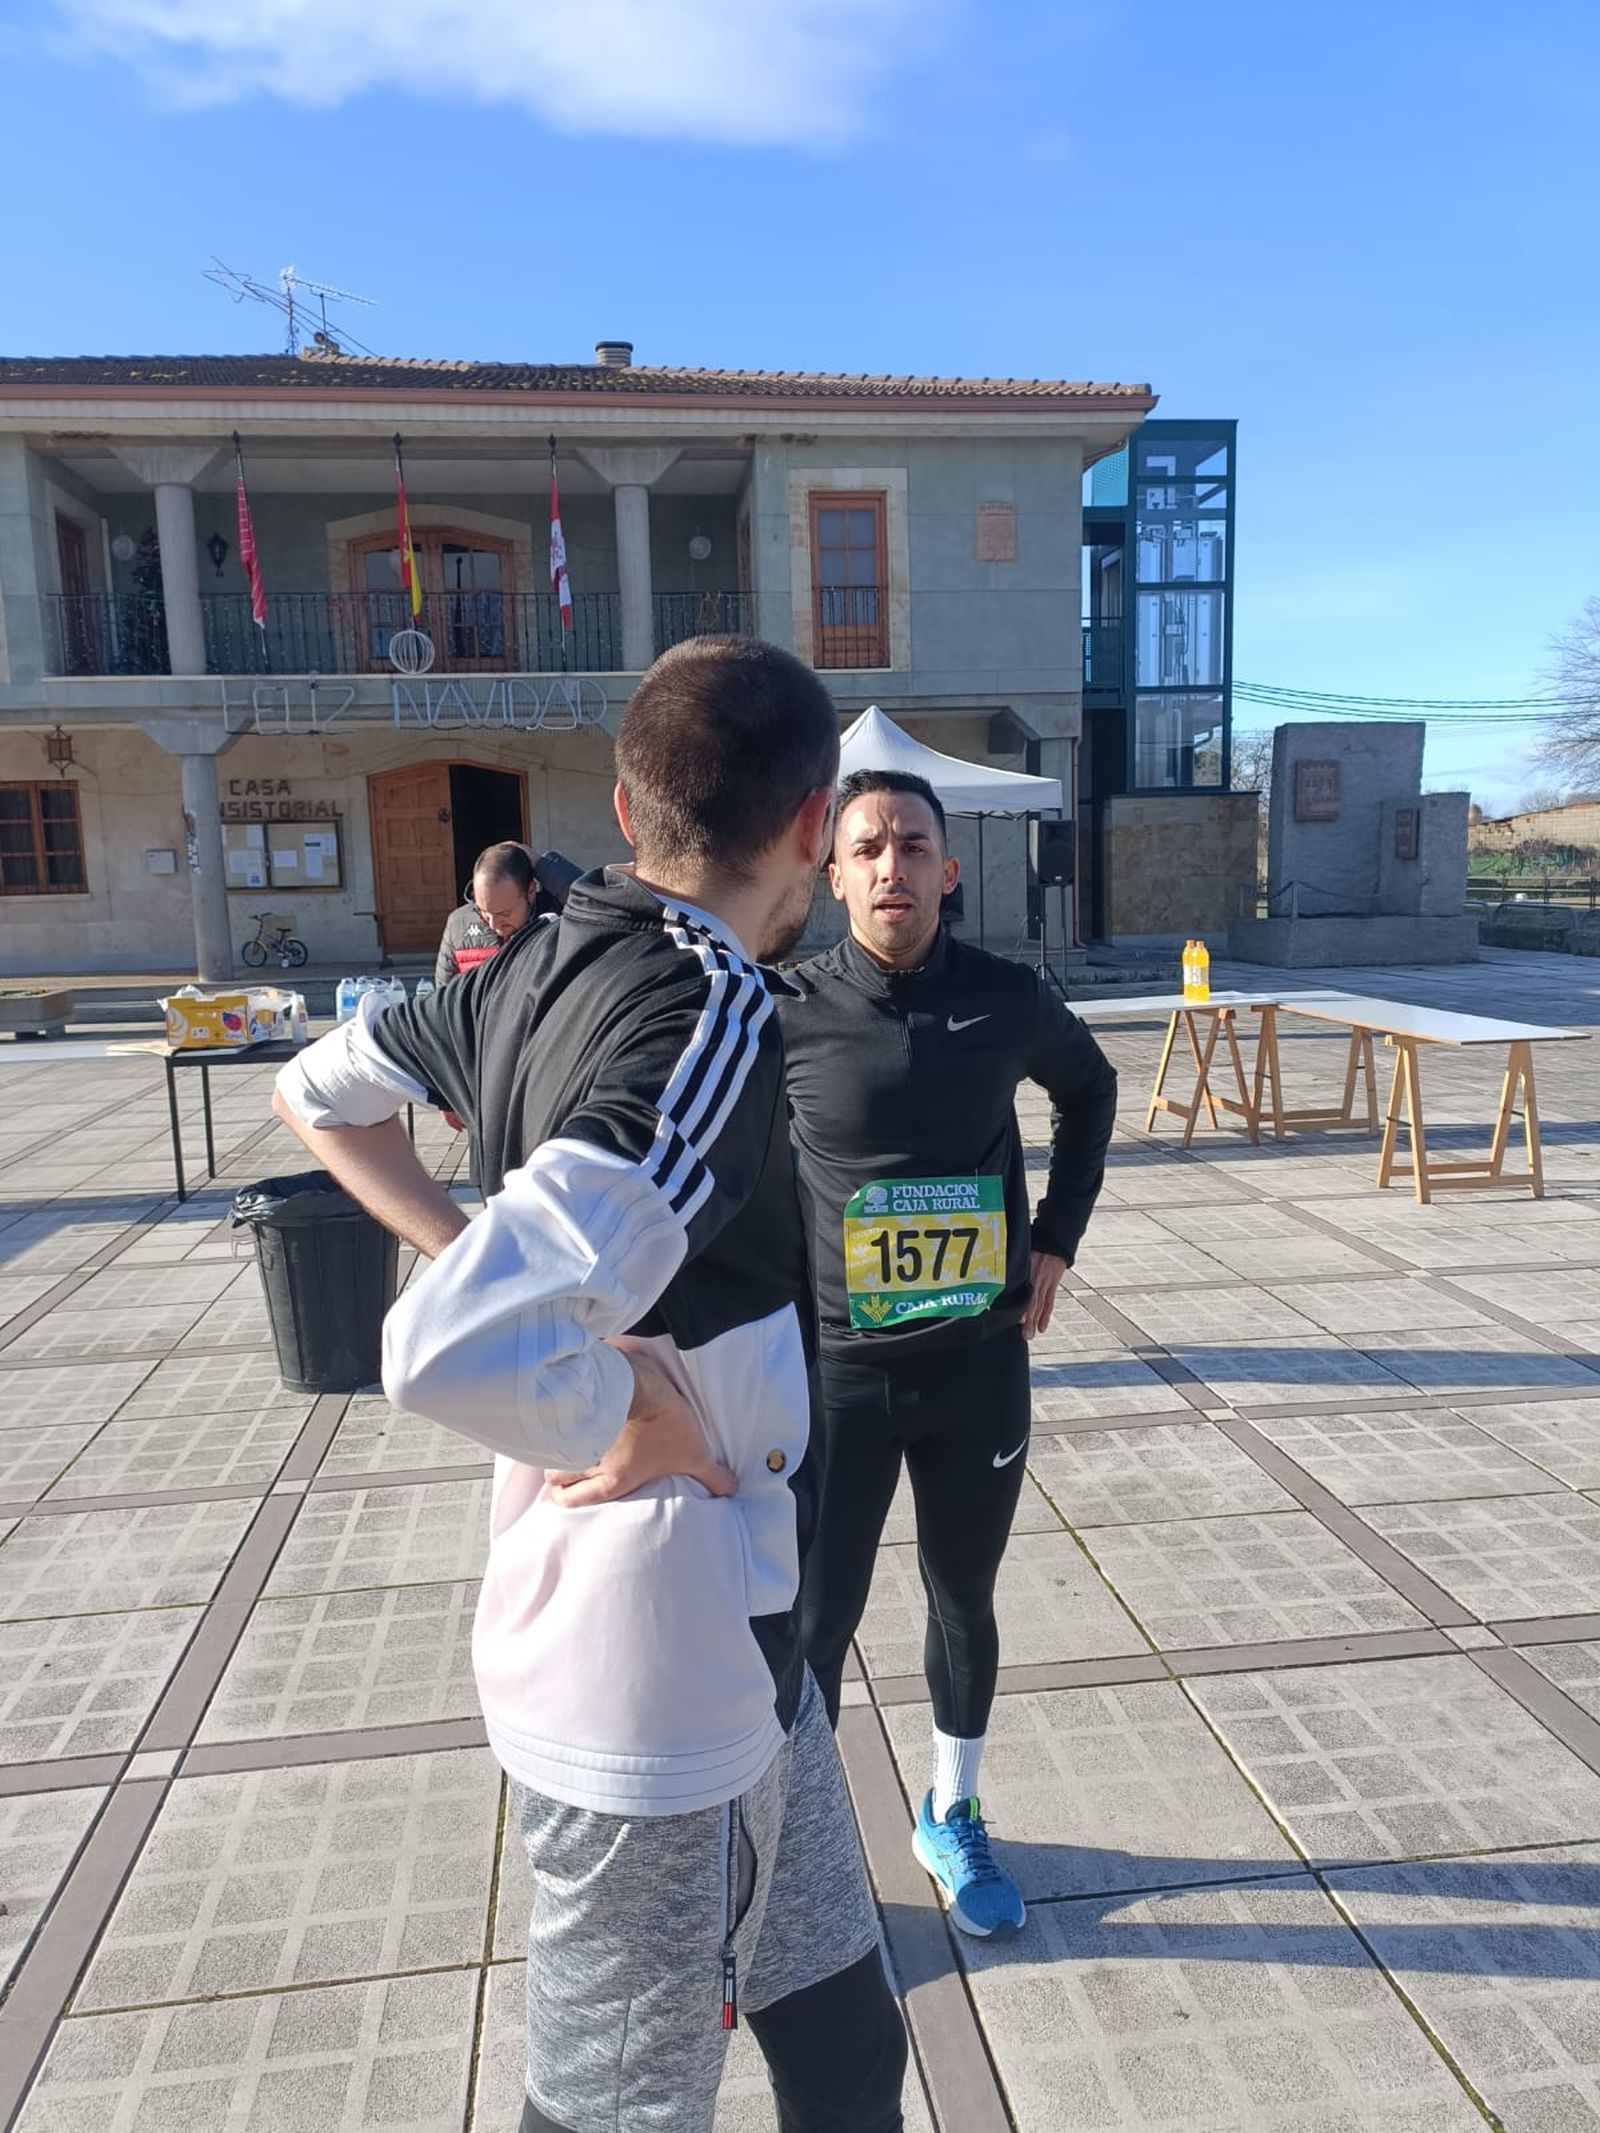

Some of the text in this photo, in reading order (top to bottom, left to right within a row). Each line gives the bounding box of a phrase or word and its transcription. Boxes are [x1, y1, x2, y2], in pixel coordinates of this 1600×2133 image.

[221, 677, 608, 736] FELIZ NAVIDAD
[229, 779, 292, 796] CASA
[220, 800, 344, 818] SISTORIAL
[893, 1197, 980, 1213] CAJA RURAL
[870, 1227, 979, 1284] 1577
